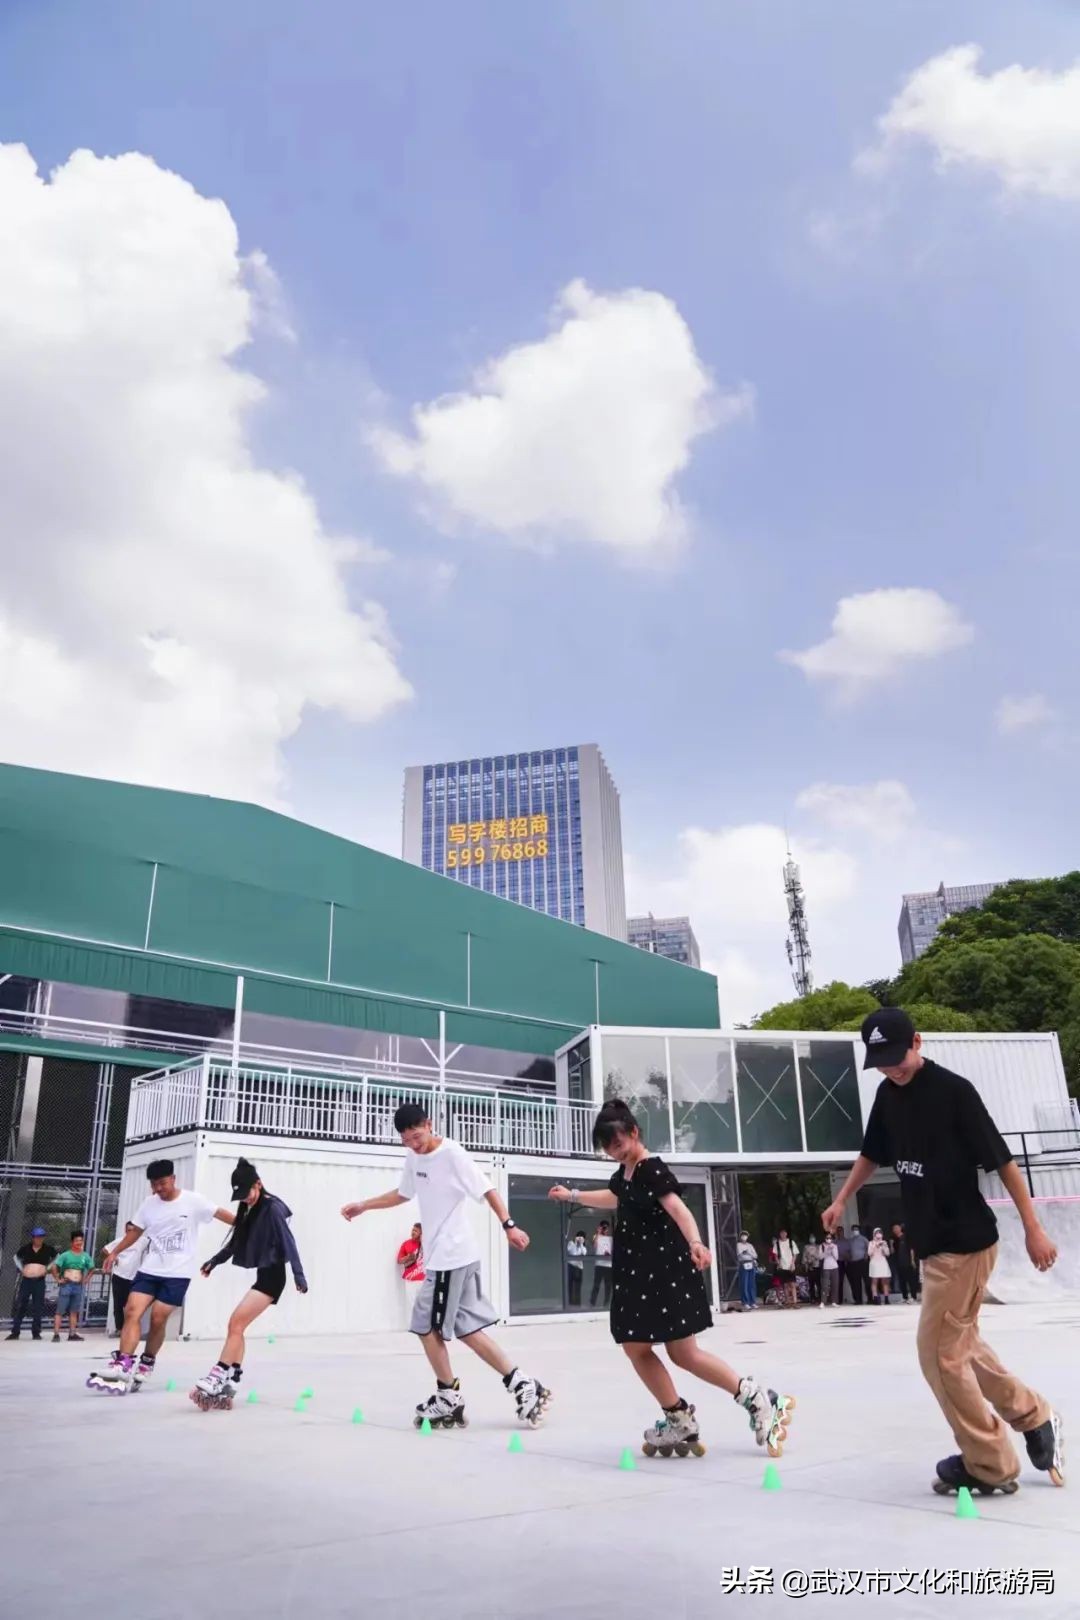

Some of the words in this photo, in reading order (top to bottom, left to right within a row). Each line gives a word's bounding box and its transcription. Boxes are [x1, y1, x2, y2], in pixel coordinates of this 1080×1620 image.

[448, 815, 548, 844] 写字楼招商
